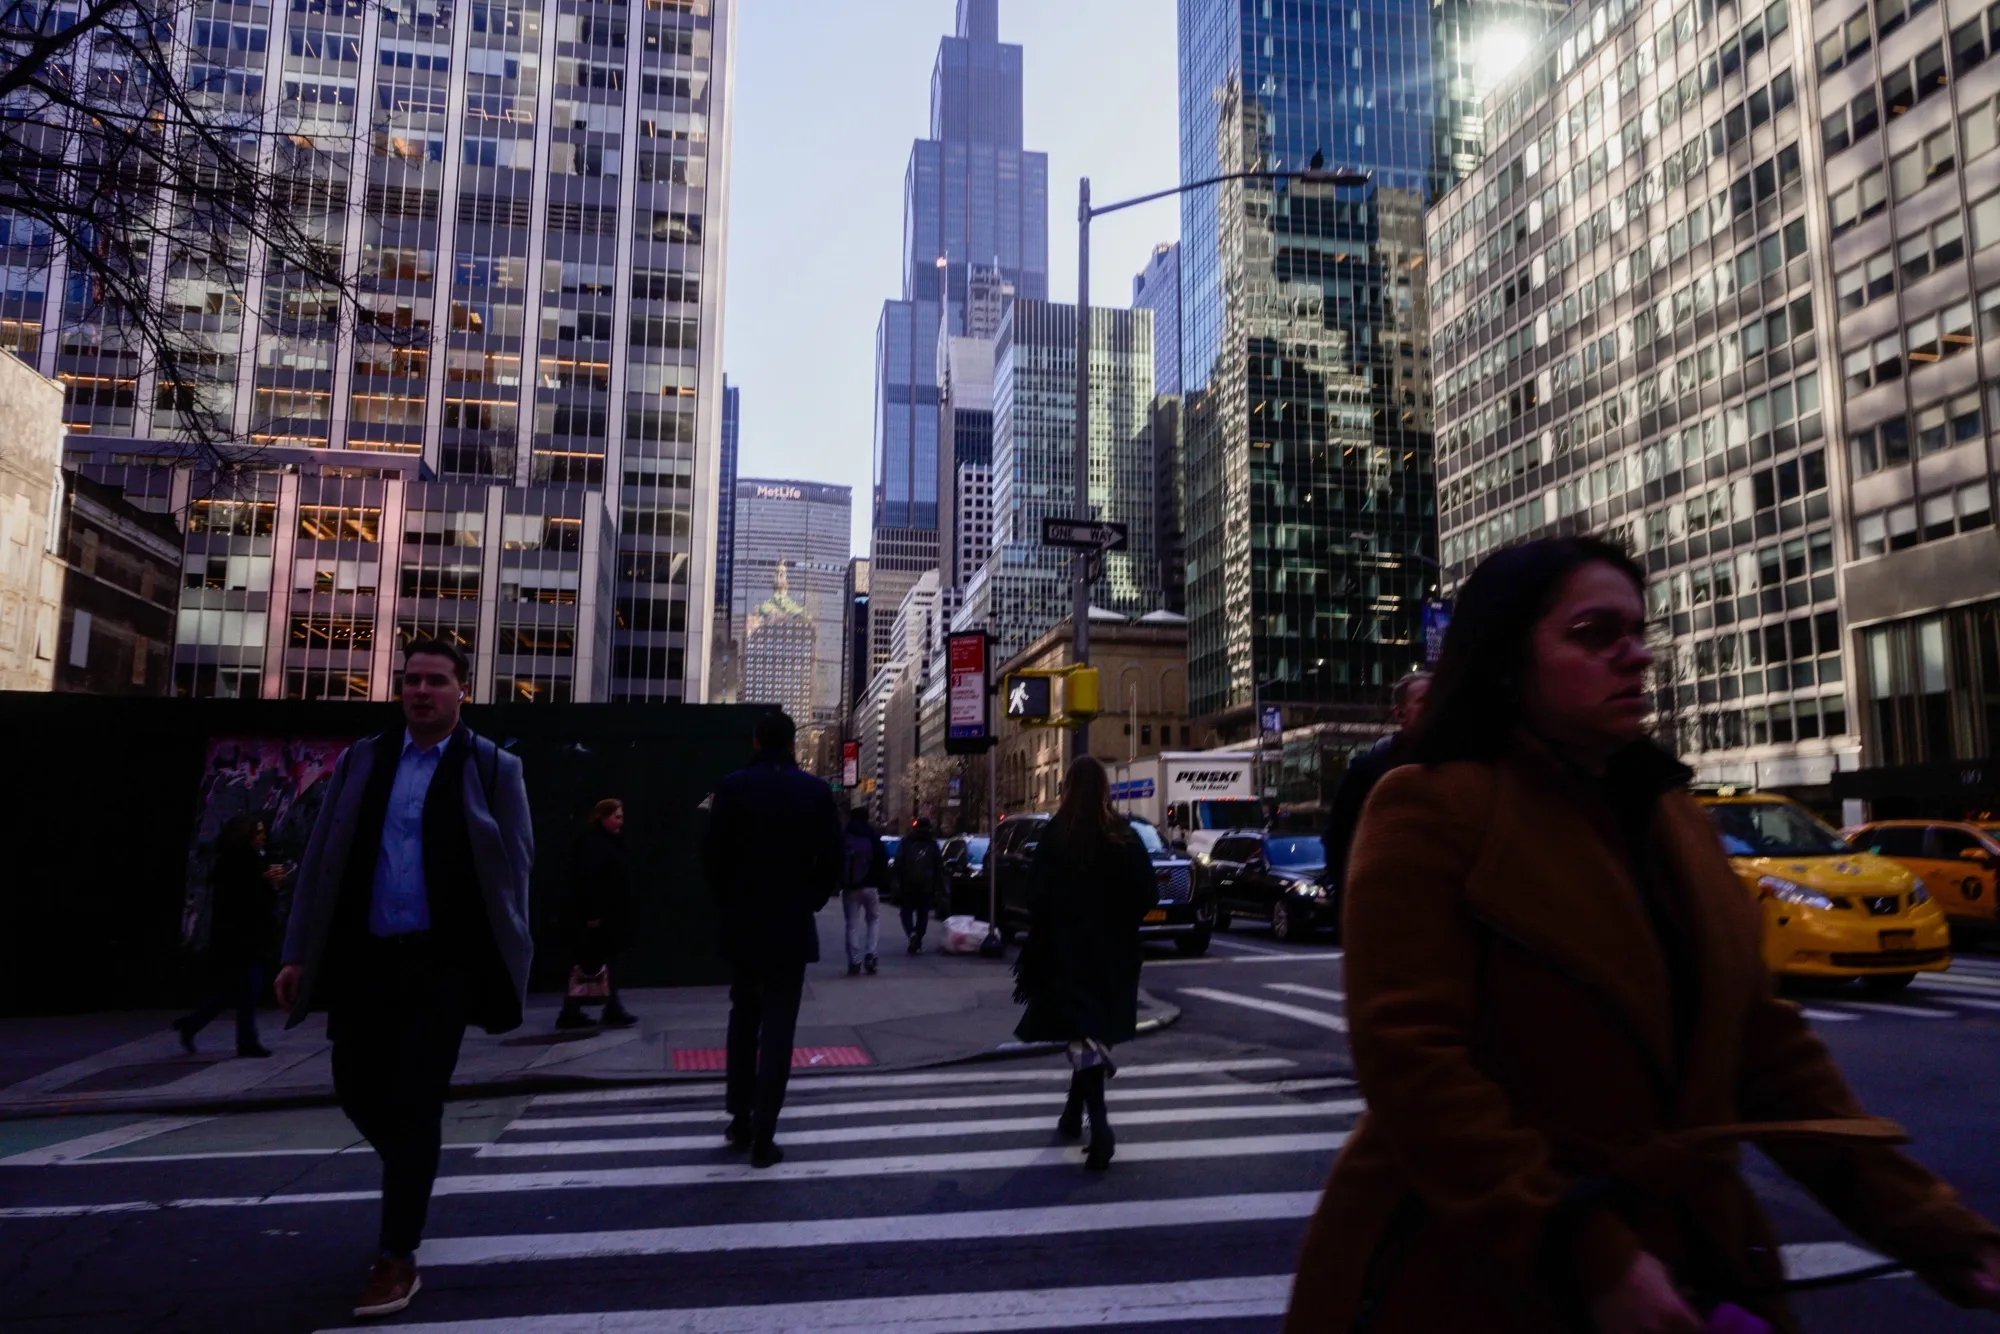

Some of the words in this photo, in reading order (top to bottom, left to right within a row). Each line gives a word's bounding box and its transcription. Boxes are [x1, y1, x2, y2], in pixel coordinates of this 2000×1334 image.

[757, 485, 801, 498] MetLife
[1052, 526, 1073, 540] ONE
[1091, 527, 1113, 543] WAY
[1176, 771, 1242, 783] PENSKE
[1190, 783, 1207, 791] Truck
[1208, 783, 1230, 791] Rental
